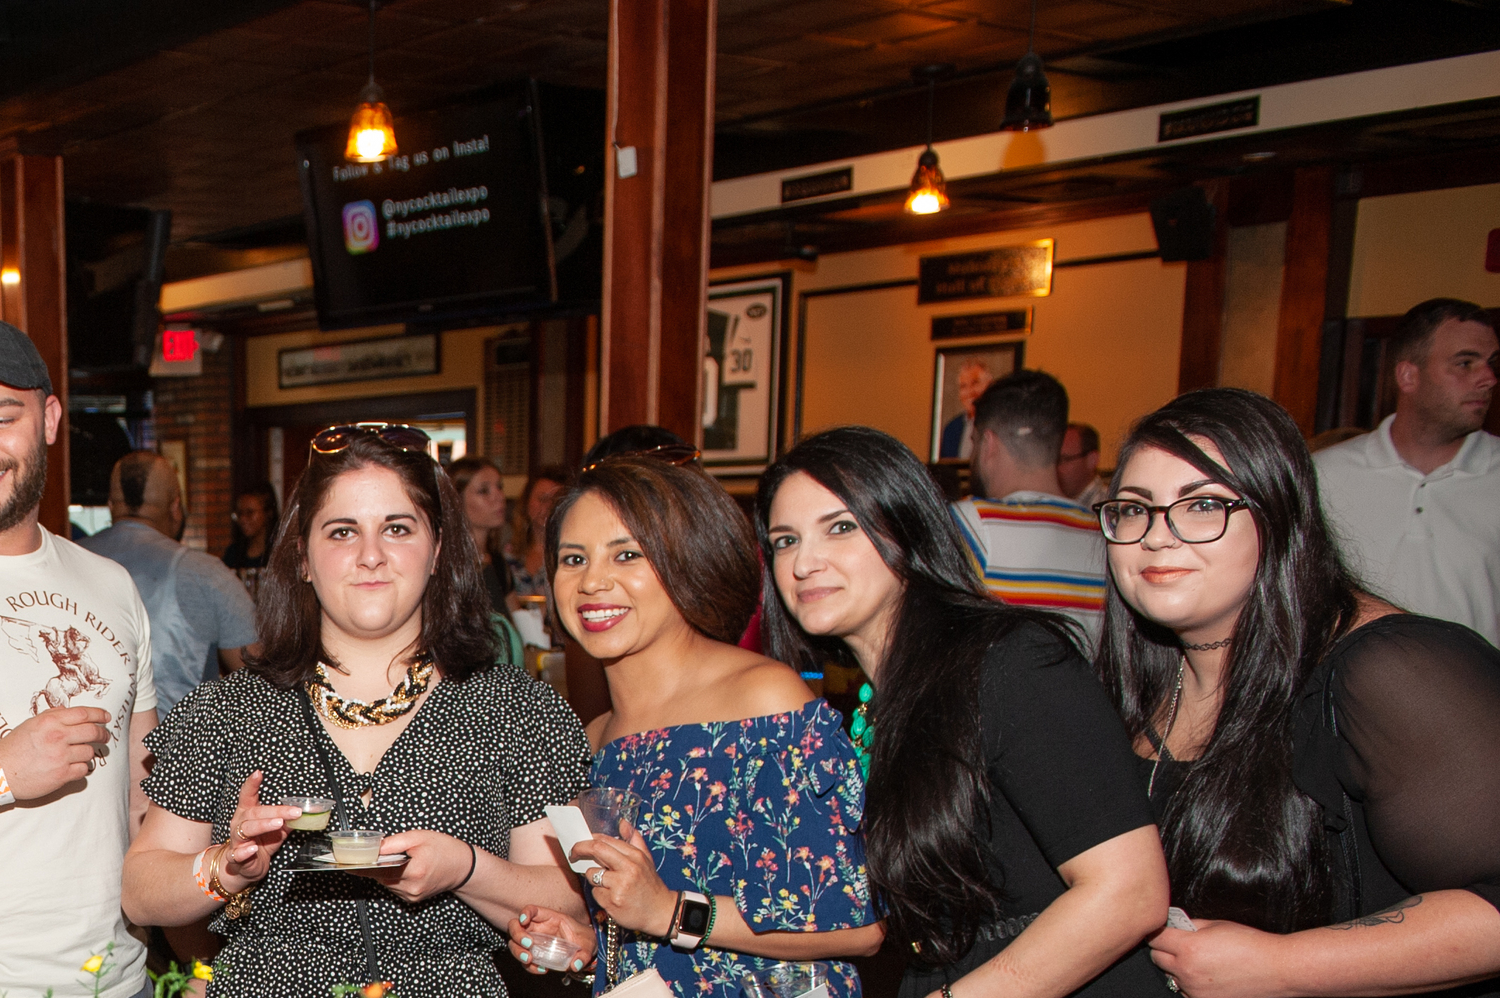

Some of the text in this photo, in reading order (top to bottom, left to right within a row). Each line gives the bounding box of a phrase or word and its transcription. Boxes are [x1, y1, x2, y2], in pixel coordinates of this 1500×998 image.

[388, 154, 410, 172] Tag
[414, 151, 429, 165] us
[433, 146, 449, 161] on
[453, 135, 489, 157] Insta!
[382, 186, 488, 219] @nycocktailexpo
[386, 209, 490, 238] #nycocktailexpo
[5, 590, 78, 616] ROUGH
[84, 611, 131, 665] RIDER
